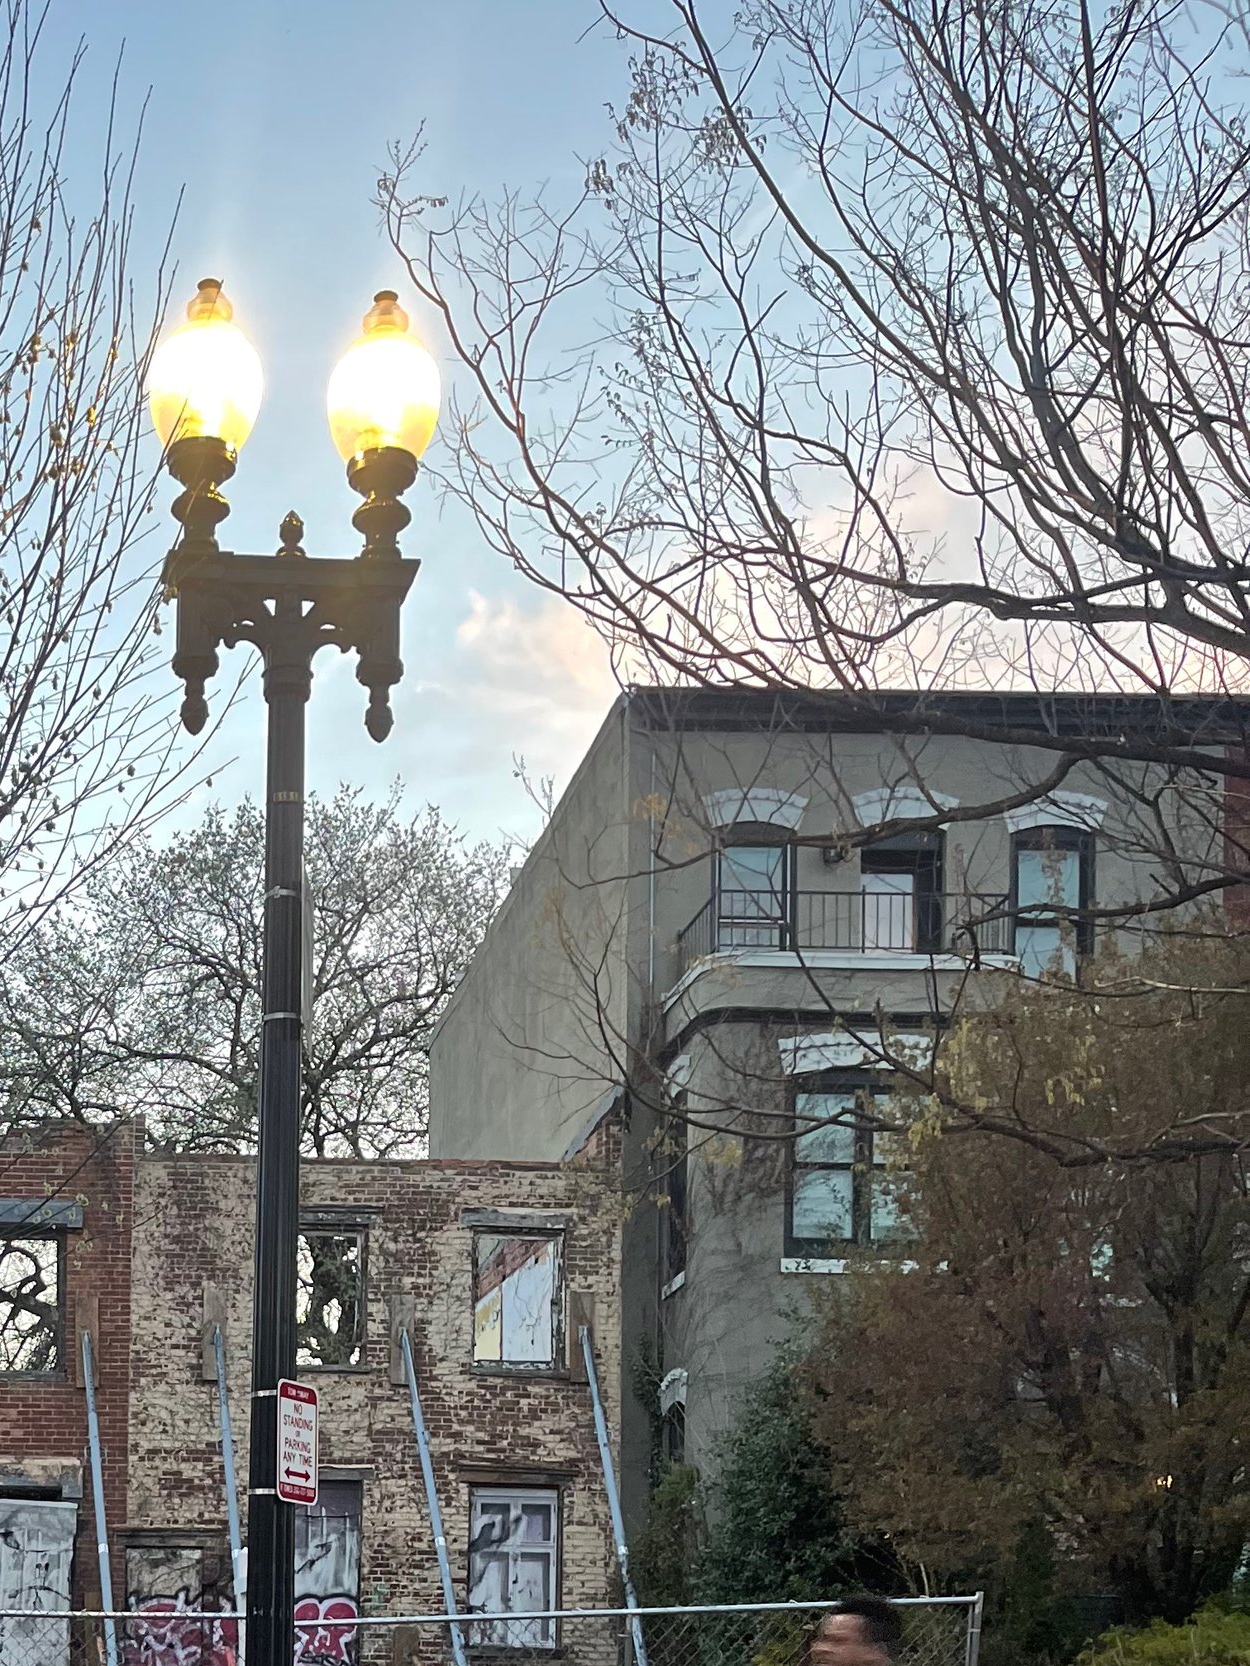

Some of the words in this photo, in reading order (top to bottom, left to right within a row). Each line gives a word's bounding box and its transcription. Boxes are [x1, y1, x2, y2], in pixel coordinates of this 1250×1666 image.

[293, 1403, 302, 1415] NO
[283, 1414, 313, 1431] STANDING
[284, 1437, 311, 1453] PARKING
[283, 1451, 296, 1463] ANY
[299, 1454, 312, 1467] TIME
